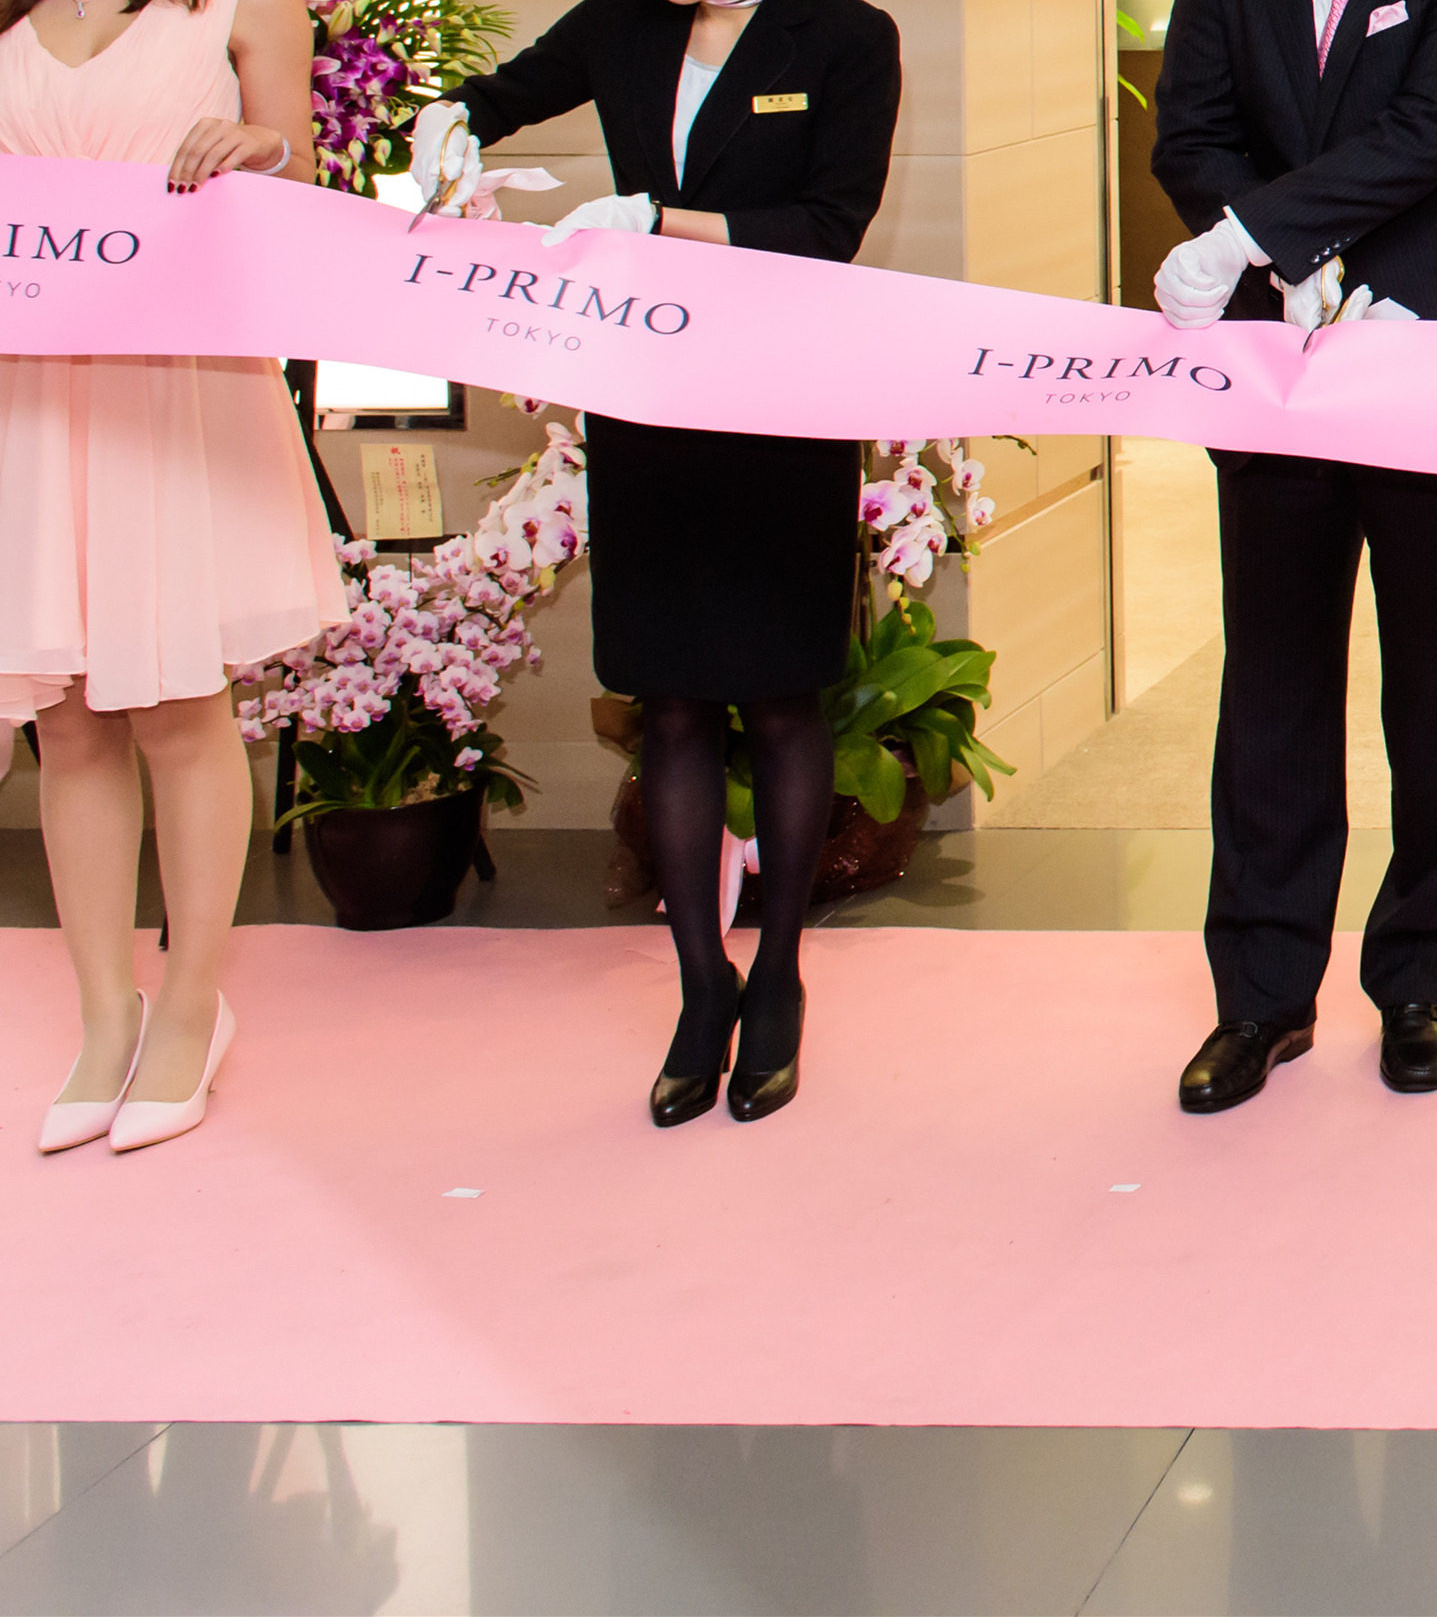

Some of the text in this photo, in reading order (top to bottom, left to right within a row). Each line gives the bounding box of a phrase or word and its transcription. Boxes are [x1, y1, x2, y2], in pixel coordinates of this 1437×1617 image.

[404, 253, 691, 337] I-PRIMO
[486, 317, 582, 353] TOKYO
[968, 347, 1232, 393] I-PRIMO
[1044, 390, 1132, 405] TOKYO
